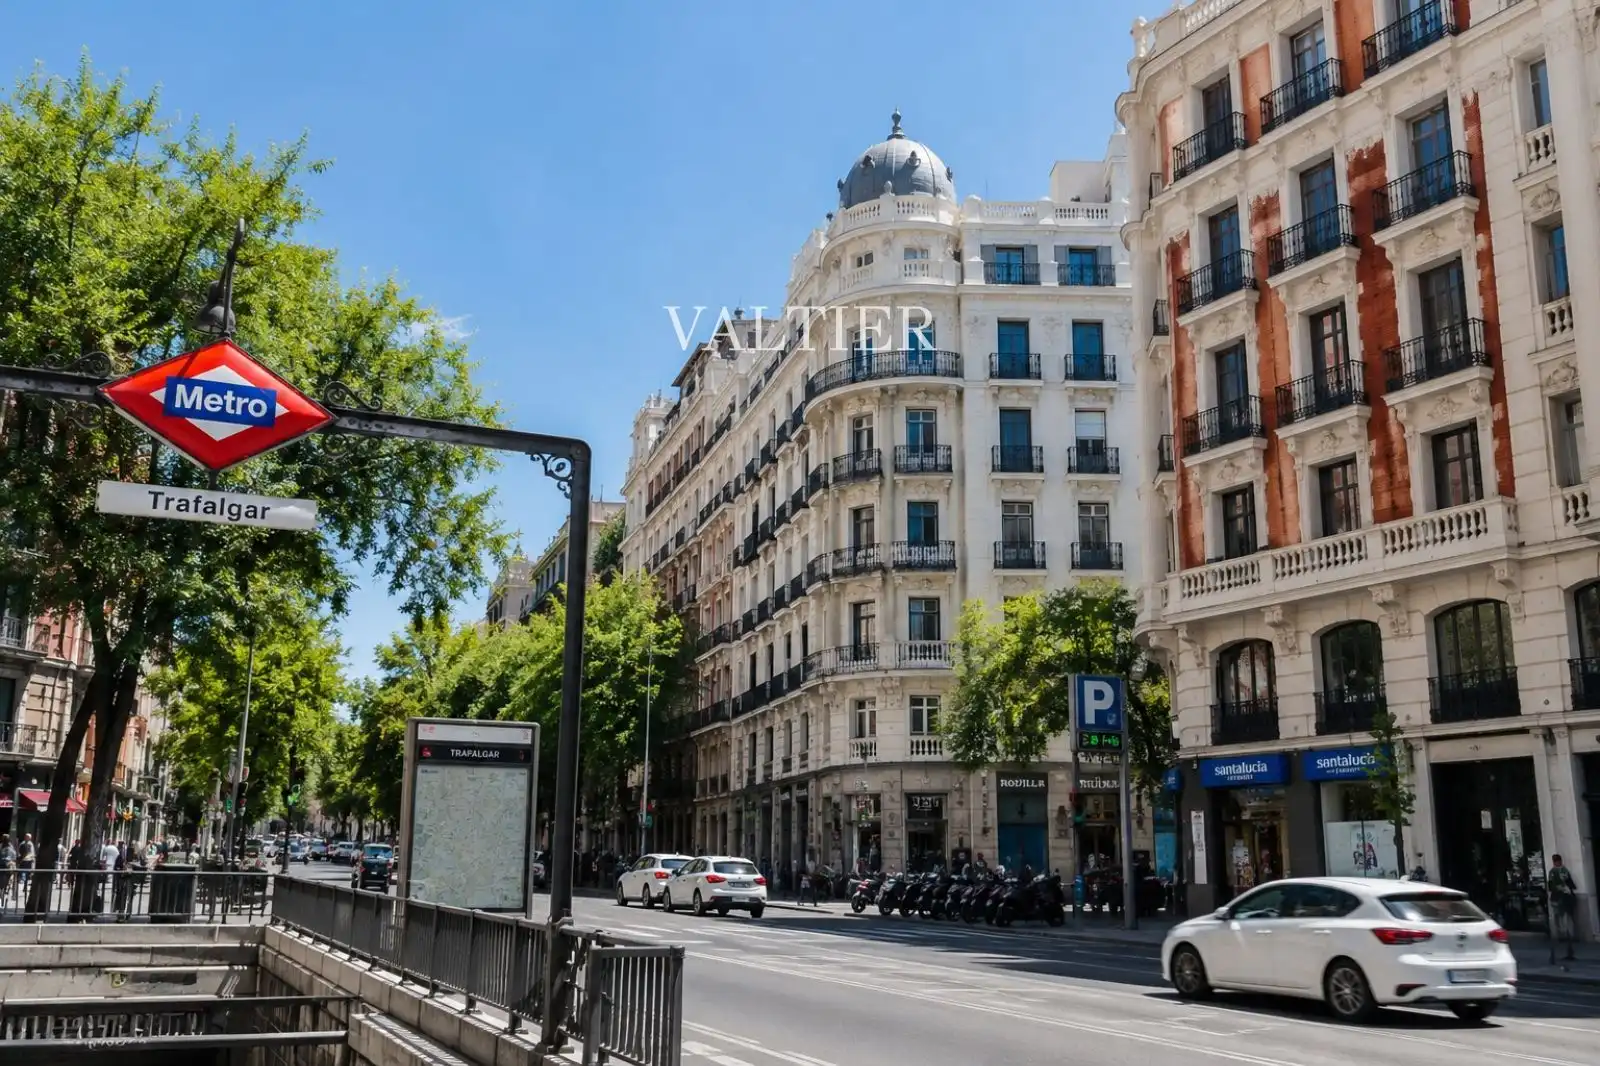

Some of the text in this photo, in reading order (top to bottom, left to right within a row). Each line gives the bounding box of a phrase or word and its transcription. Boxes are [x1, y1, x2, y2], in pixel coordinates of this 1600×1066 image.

[174, 383, 268, 418] Metro
[149, 490, 271, 522] Trafalgar
[1084, 680, 1115, 725] P
[450, 748, 500, 759] TRAFALGAR
